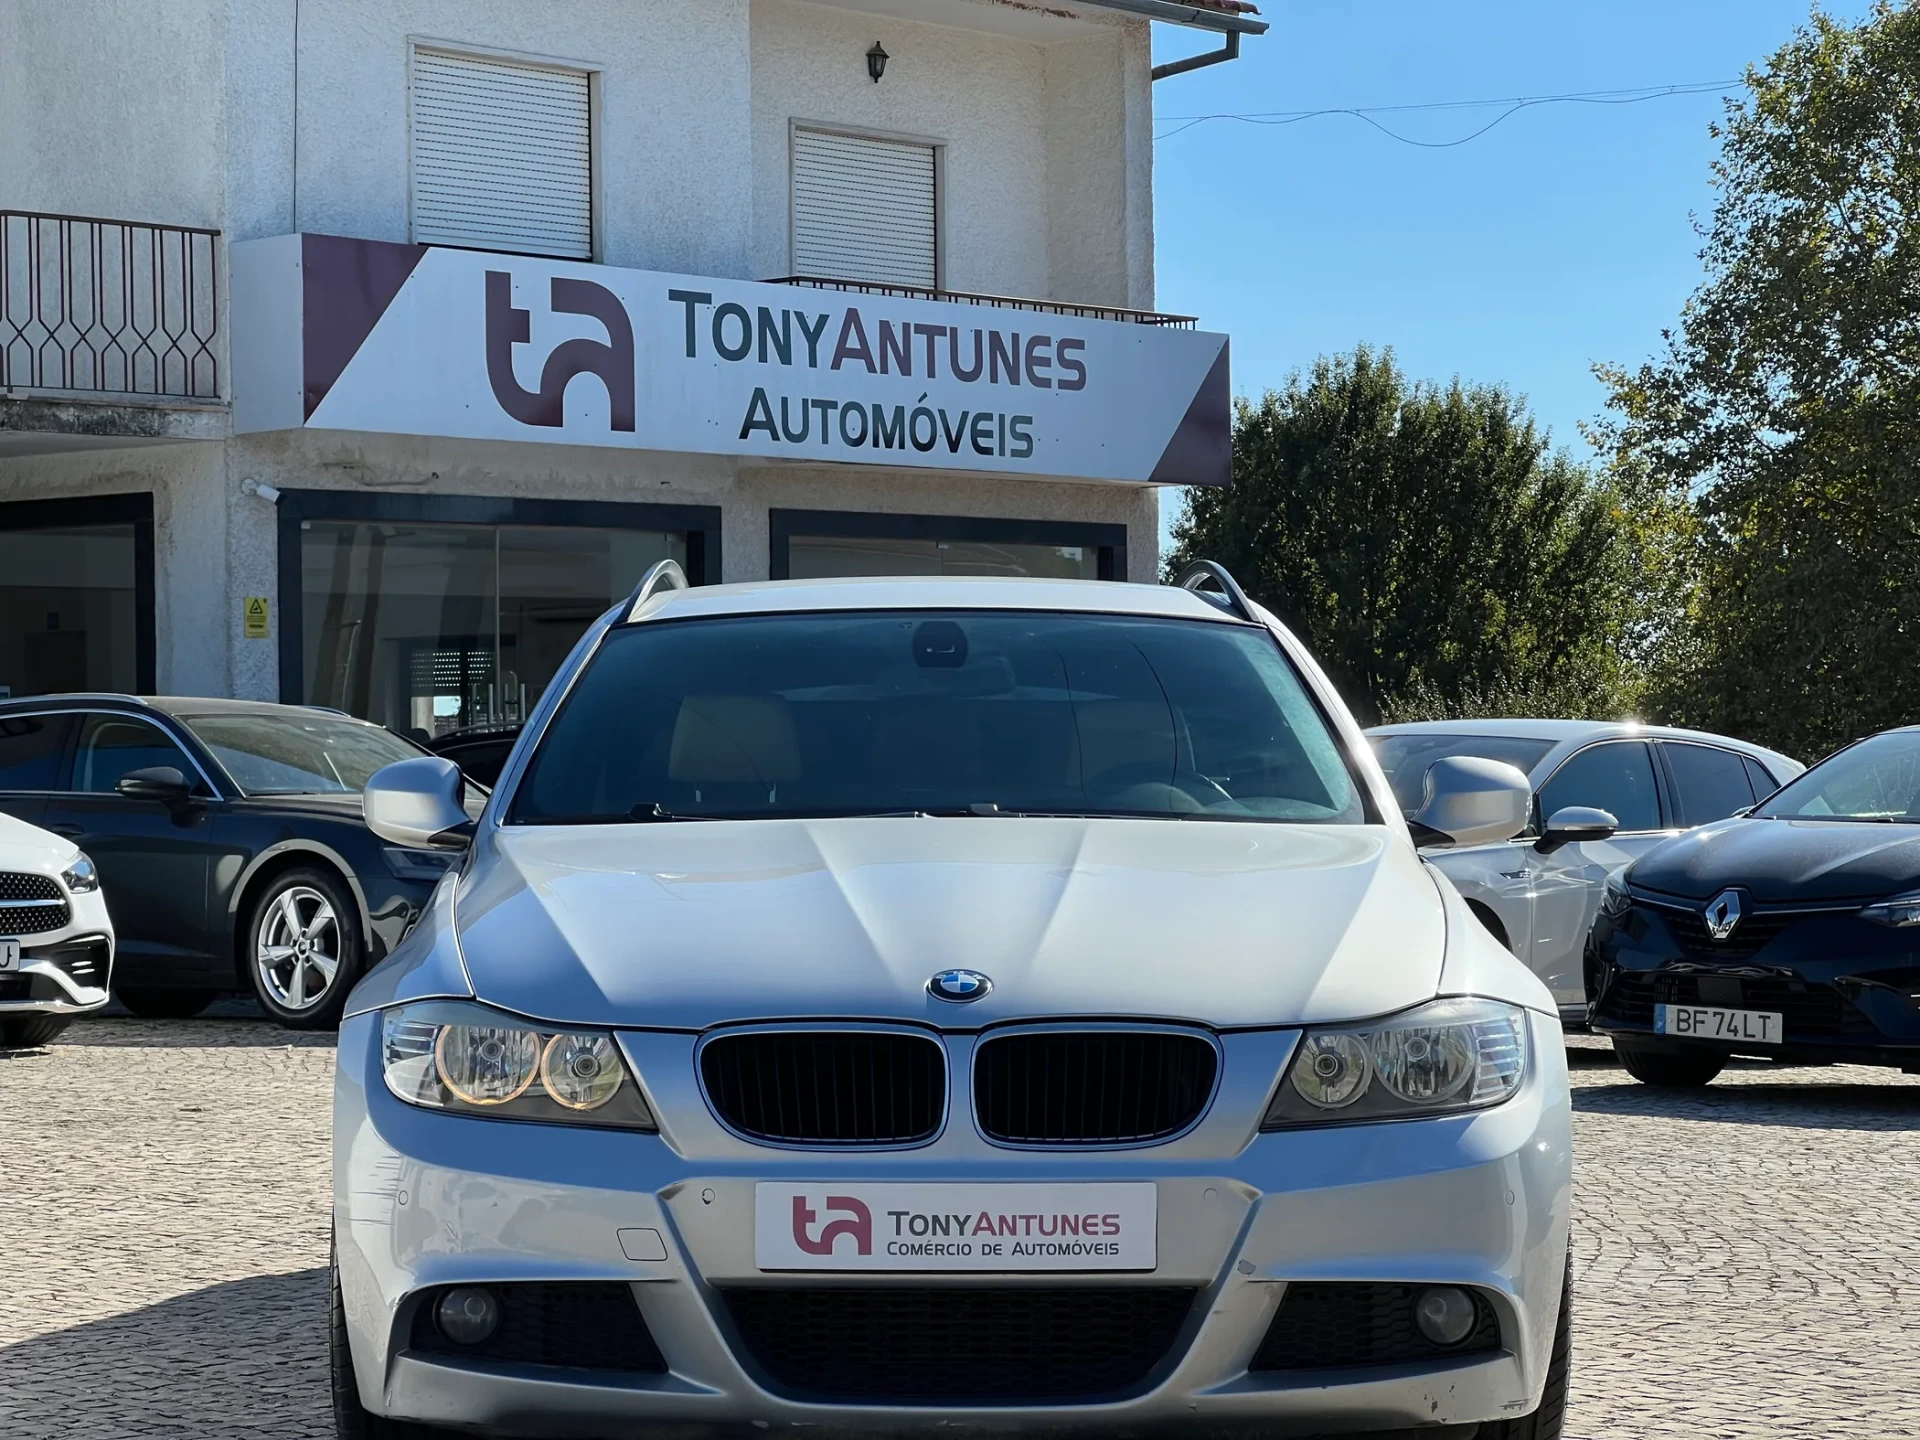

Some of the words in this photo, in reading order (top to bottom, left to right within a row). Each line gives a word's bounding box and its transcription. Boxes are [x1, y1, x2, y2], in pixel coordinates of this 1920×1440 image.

[739, 387, 1033, 459] AUTOMÓVEIS
[887, 1240, 972, 1256] COMÉRCIO
[982, 1243, 1002, 1256] DE
[1011, 1239, 1119, 1256] AUTOMÓVEIS
